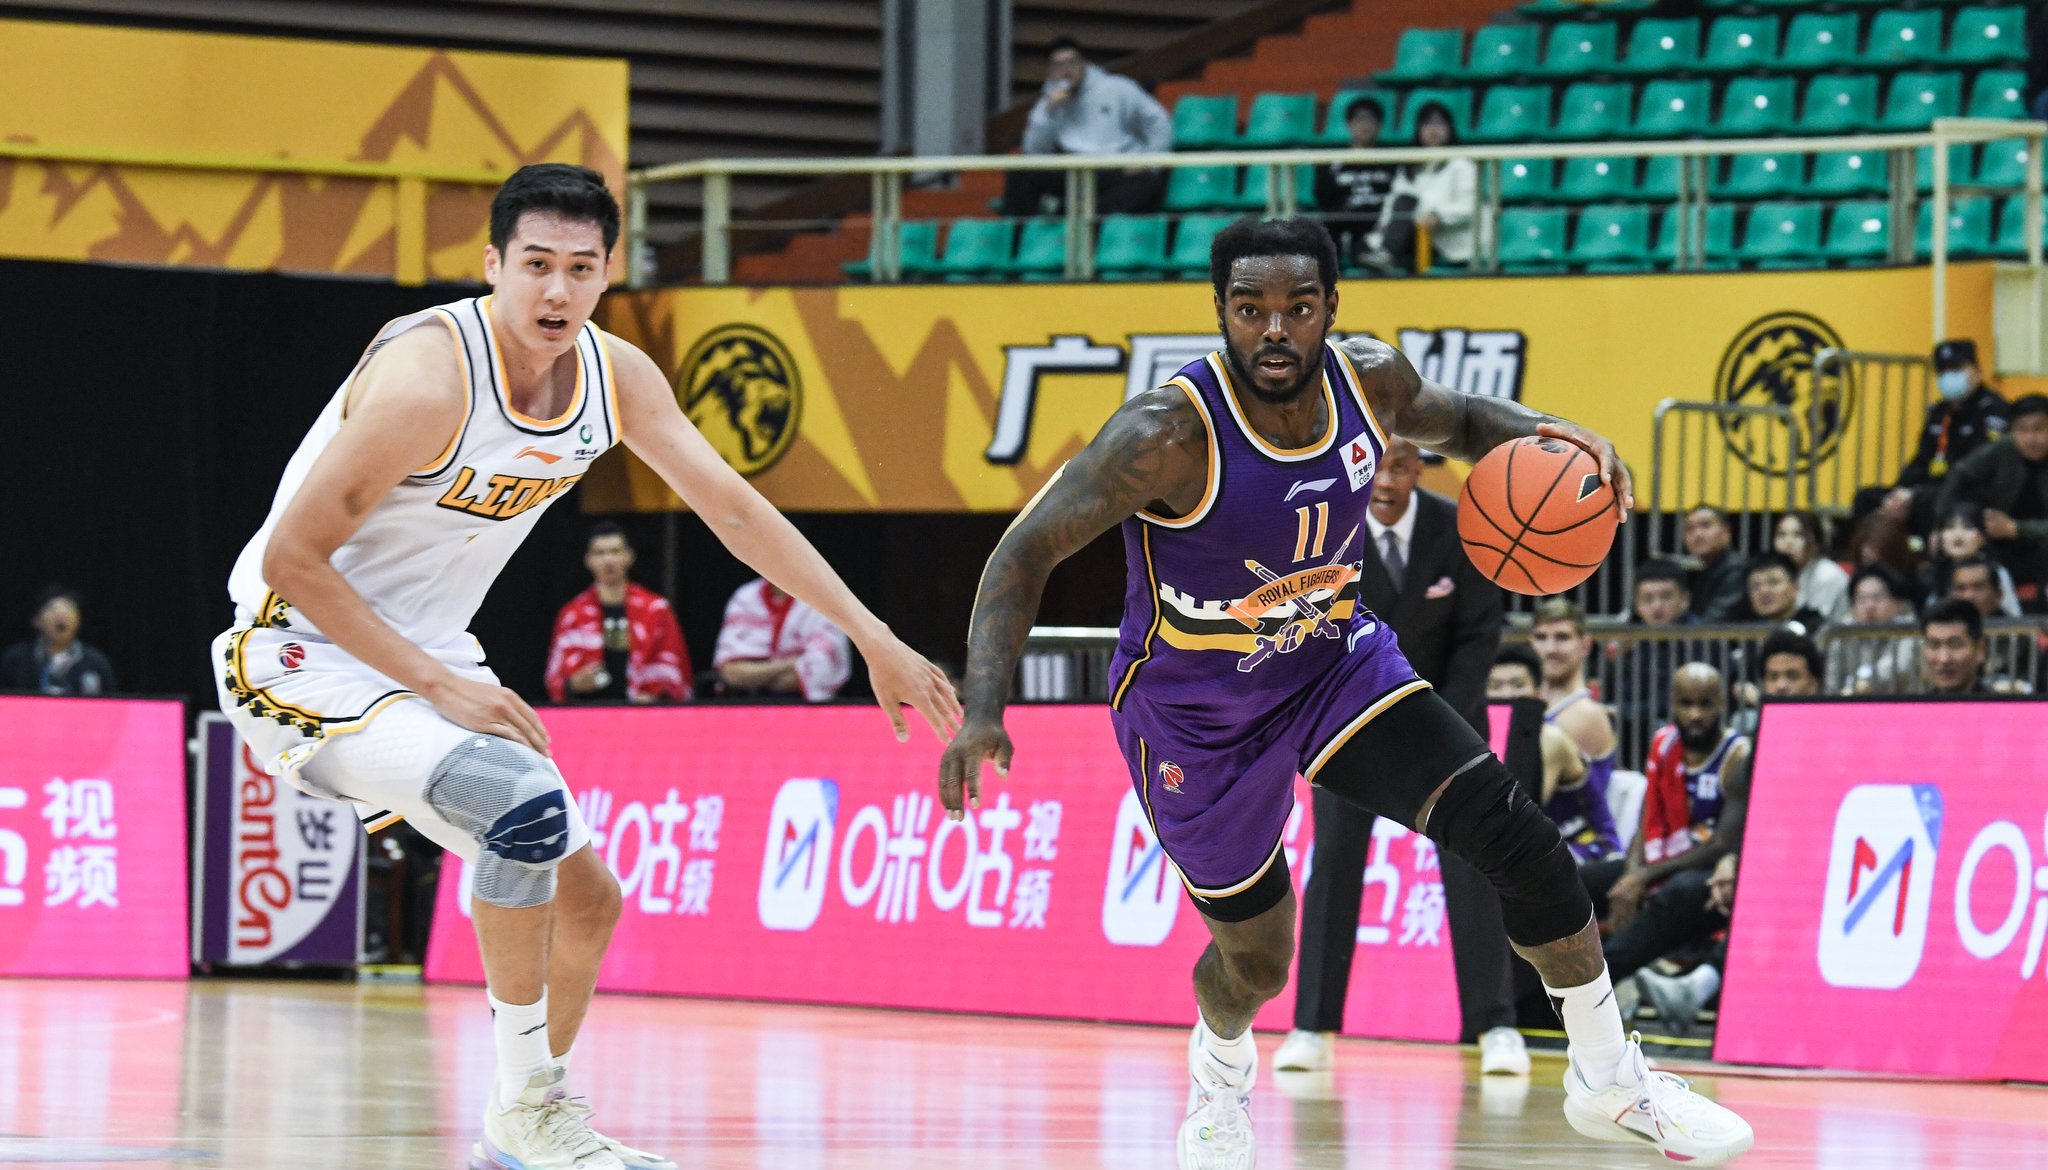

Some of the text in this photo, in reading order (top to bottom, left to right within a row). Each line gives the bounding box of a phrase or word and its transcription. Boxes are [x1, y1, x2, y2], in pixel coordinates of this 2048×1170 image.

[1292, 501, 1328, 563] 11
[1257, 569, 1340, 607] ROYAL FIGHTERS
[41, 777, 119, 908] 视频
